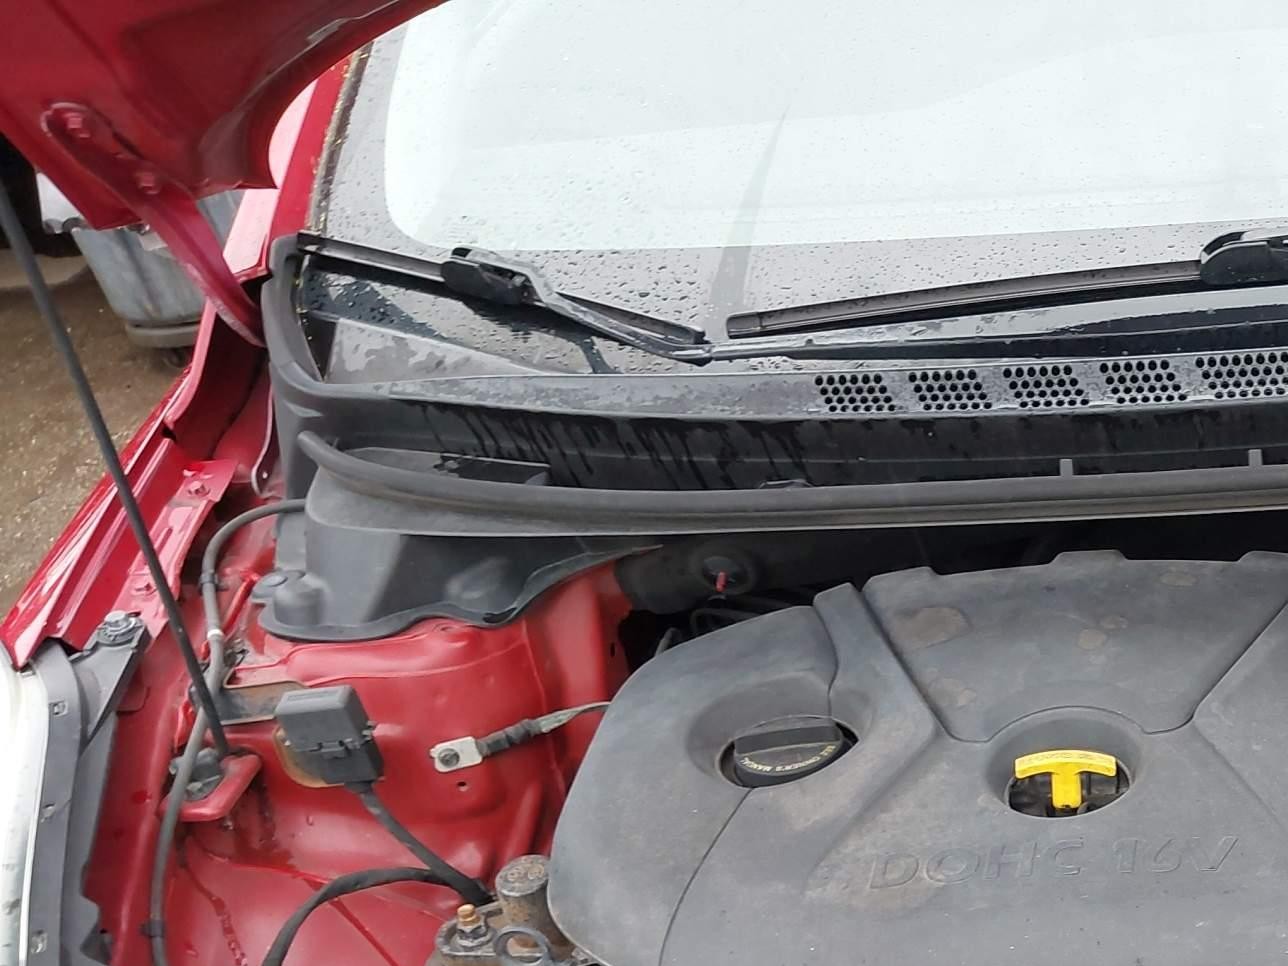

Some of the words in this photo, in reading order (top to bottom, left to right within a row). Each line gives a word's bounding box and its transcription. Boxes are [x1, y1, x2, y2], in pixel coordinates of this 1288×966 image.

[739, 757, 773, 772] MANUAL
[775, 756, 820, 772] OWNER'S
[867, 836, 1085, 890] DOHC
[1113, 835, 1239, 874] 16V
